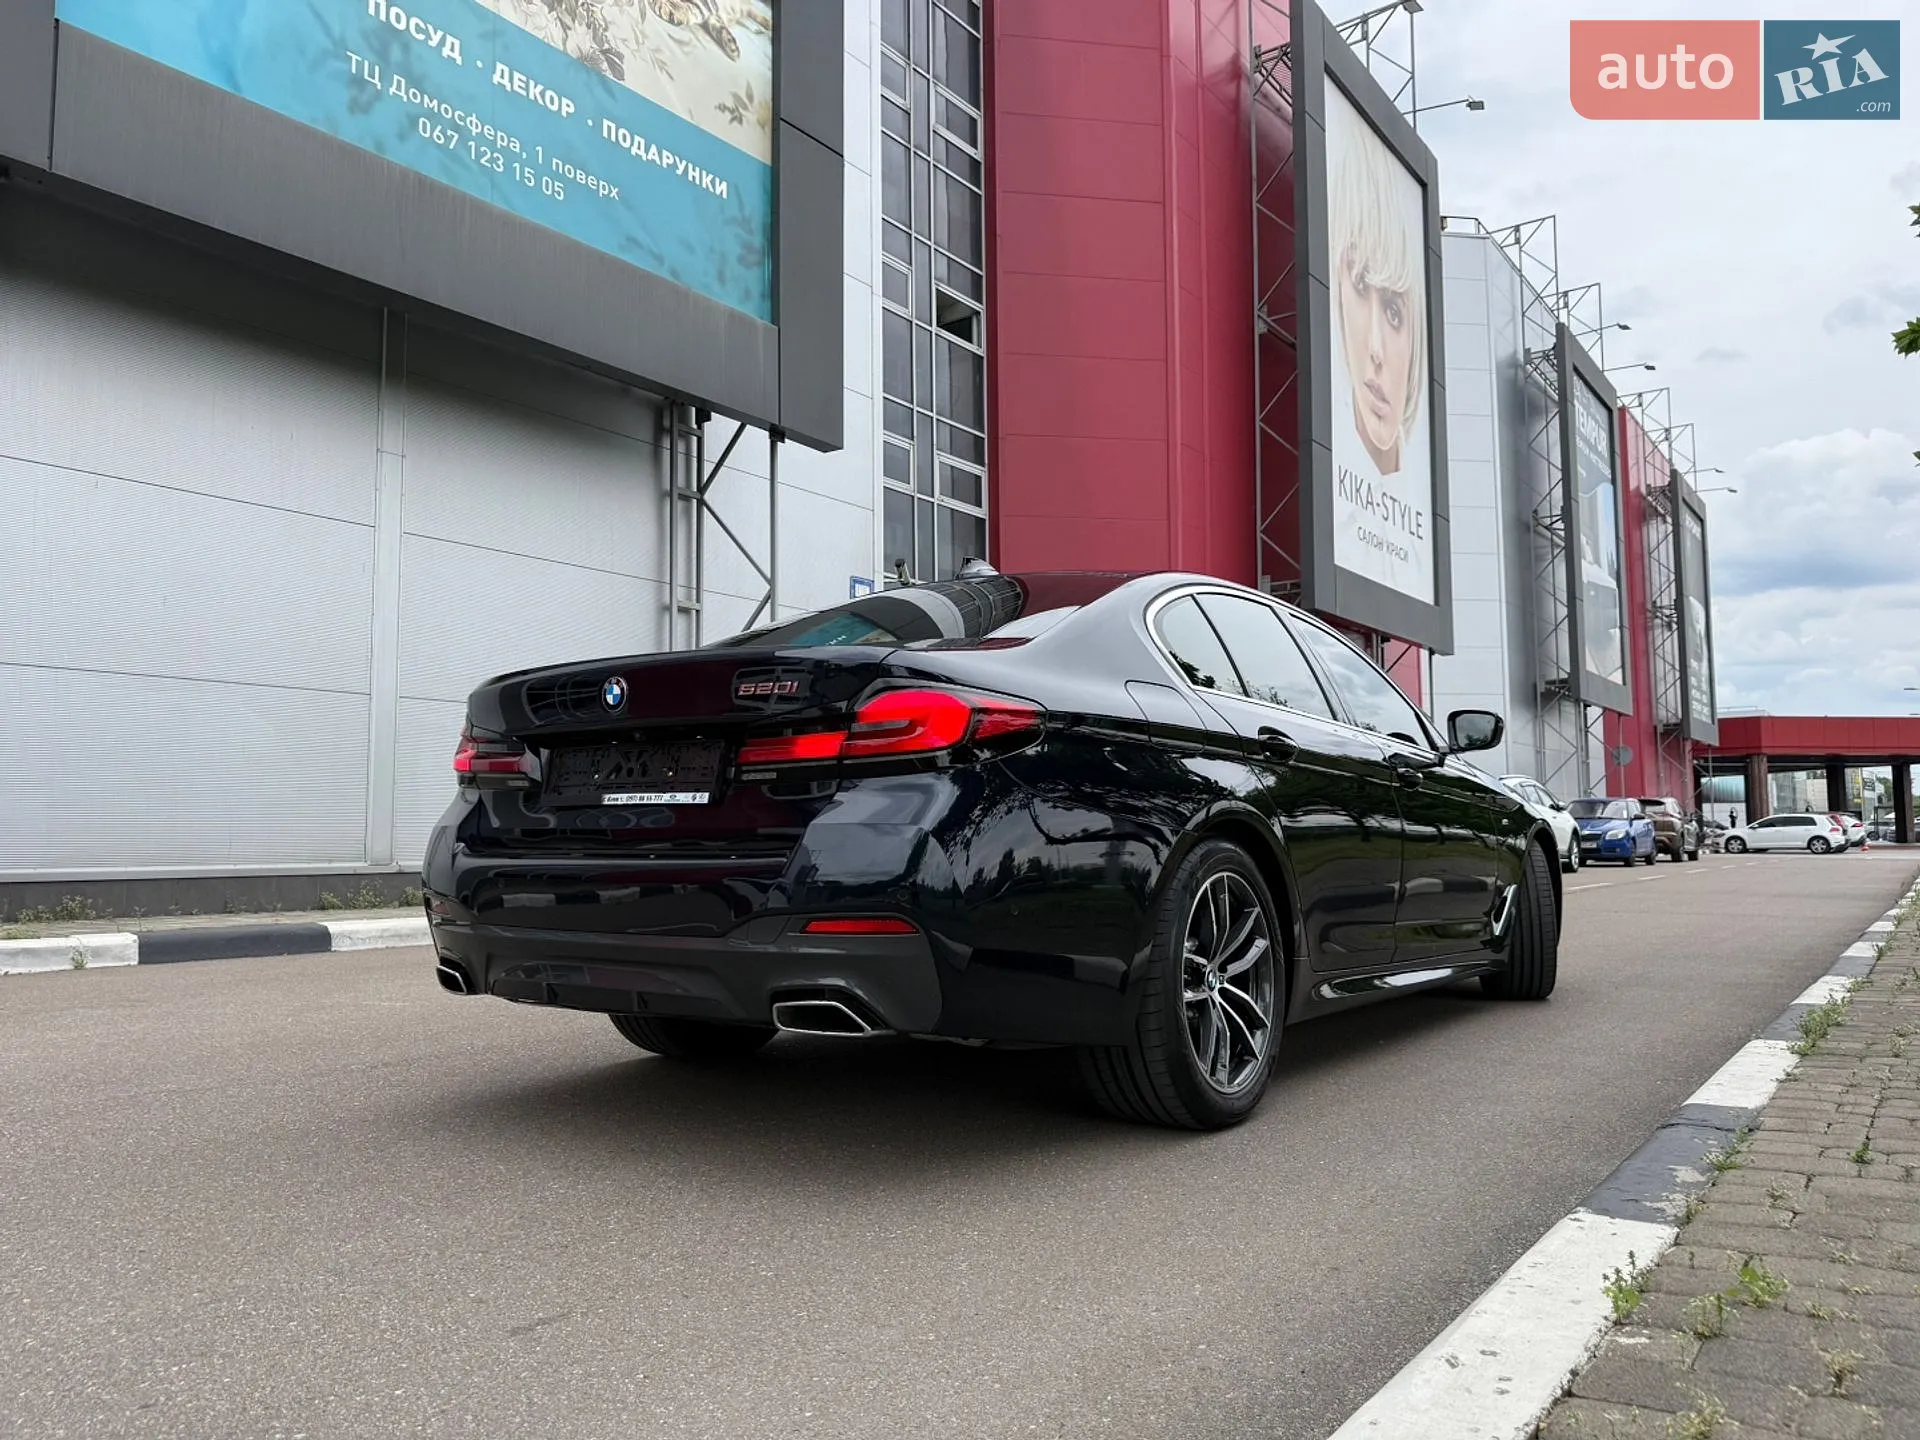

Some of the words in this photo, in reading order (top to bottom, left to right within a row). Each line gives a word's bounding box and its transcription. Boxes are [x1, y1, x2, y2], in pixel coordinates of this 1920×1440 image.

[346, 51, 382, 90] ТЦ
[389, 74, 527, 160] Домосфера,
[535, 145, 543, 165] 1
[552, 157, 620, 201] поверх
[368, 0, 462, 66] ПОСУД
[492, 61, 575, 119] ДЕКОР
[602, 118, 729, 199] ПОДАРУНКИ
[418, 117, 460, 150] 067
[467, 140, 505, 173] 123
[512, 162, 535, 188] 15
[542, 176, 565, 201] 05
[1338, 465, 1424, 541] KIKA-STYLE
[1357, 526, 1384, 551] САЛОН
